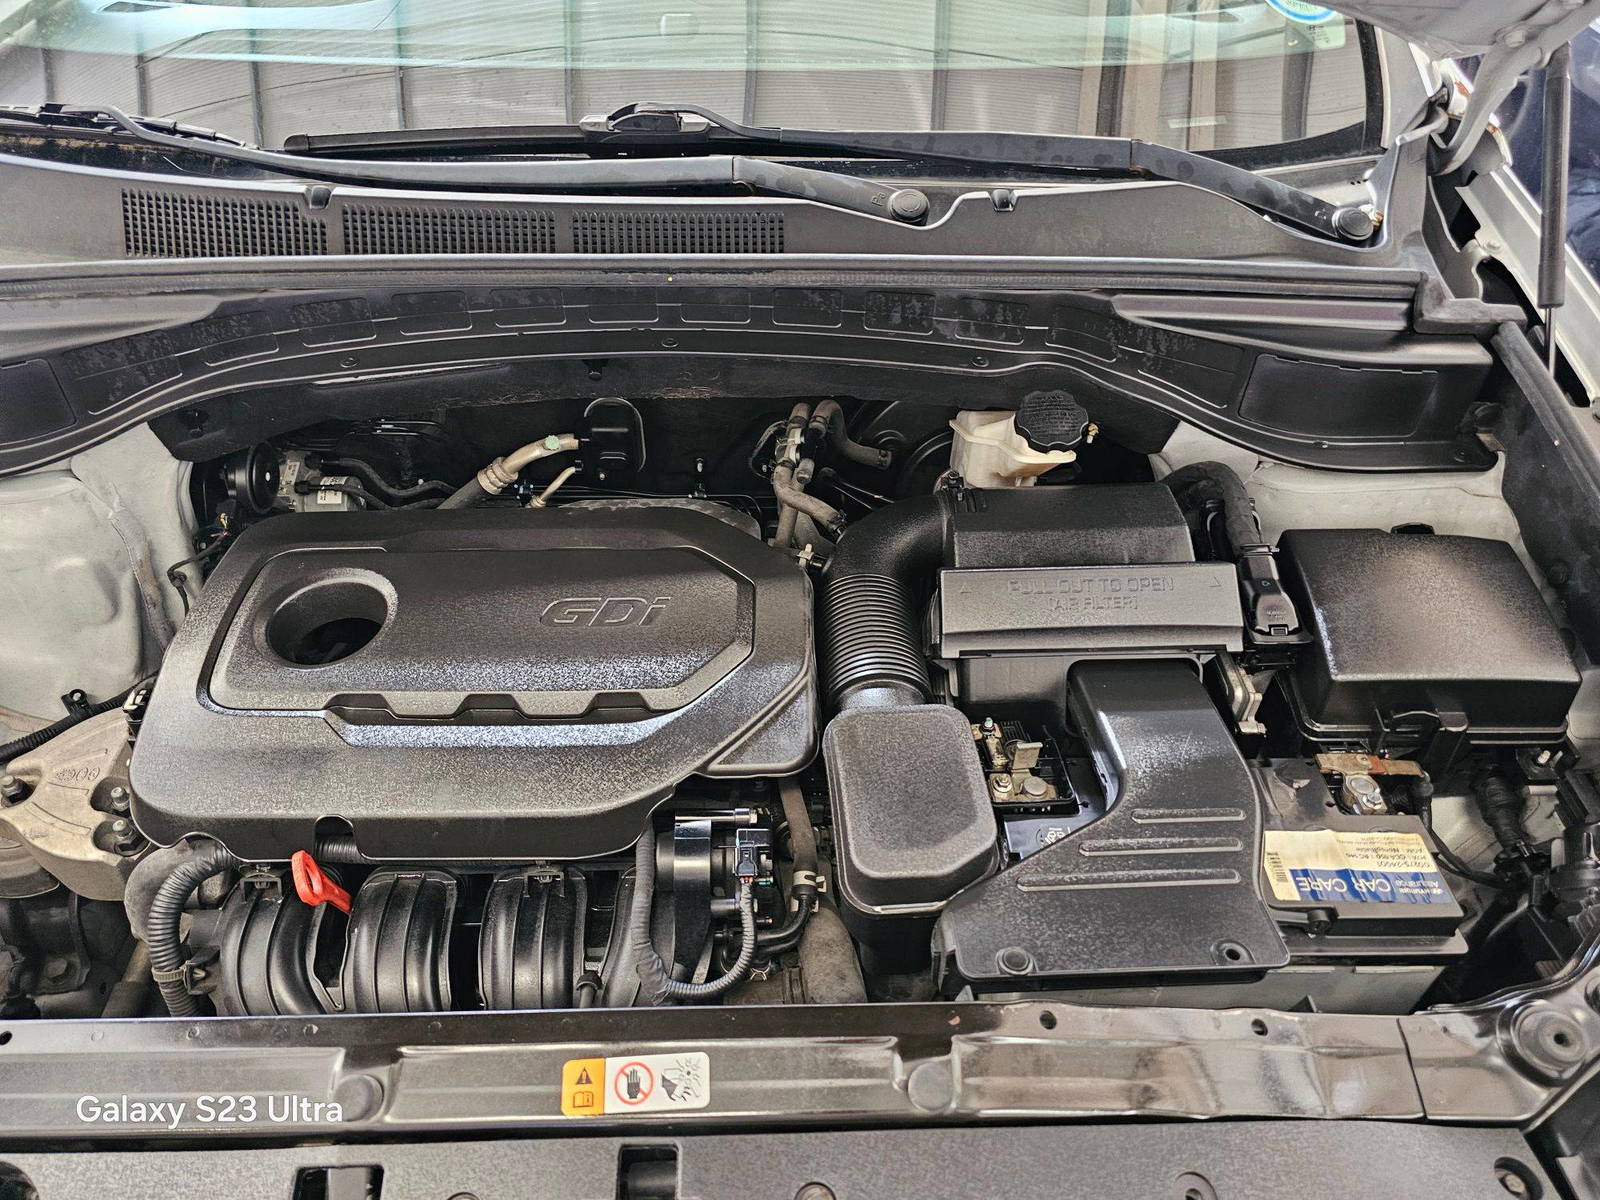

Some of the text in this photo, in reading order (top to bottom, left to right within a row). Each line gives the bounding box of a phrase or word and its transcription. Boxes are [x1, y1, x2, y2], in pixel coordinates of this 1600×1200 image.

[1008, 576, 1175, 595] PULL OUT TO OPEN
[1295, 876, 1391, 894] CAR CARE
